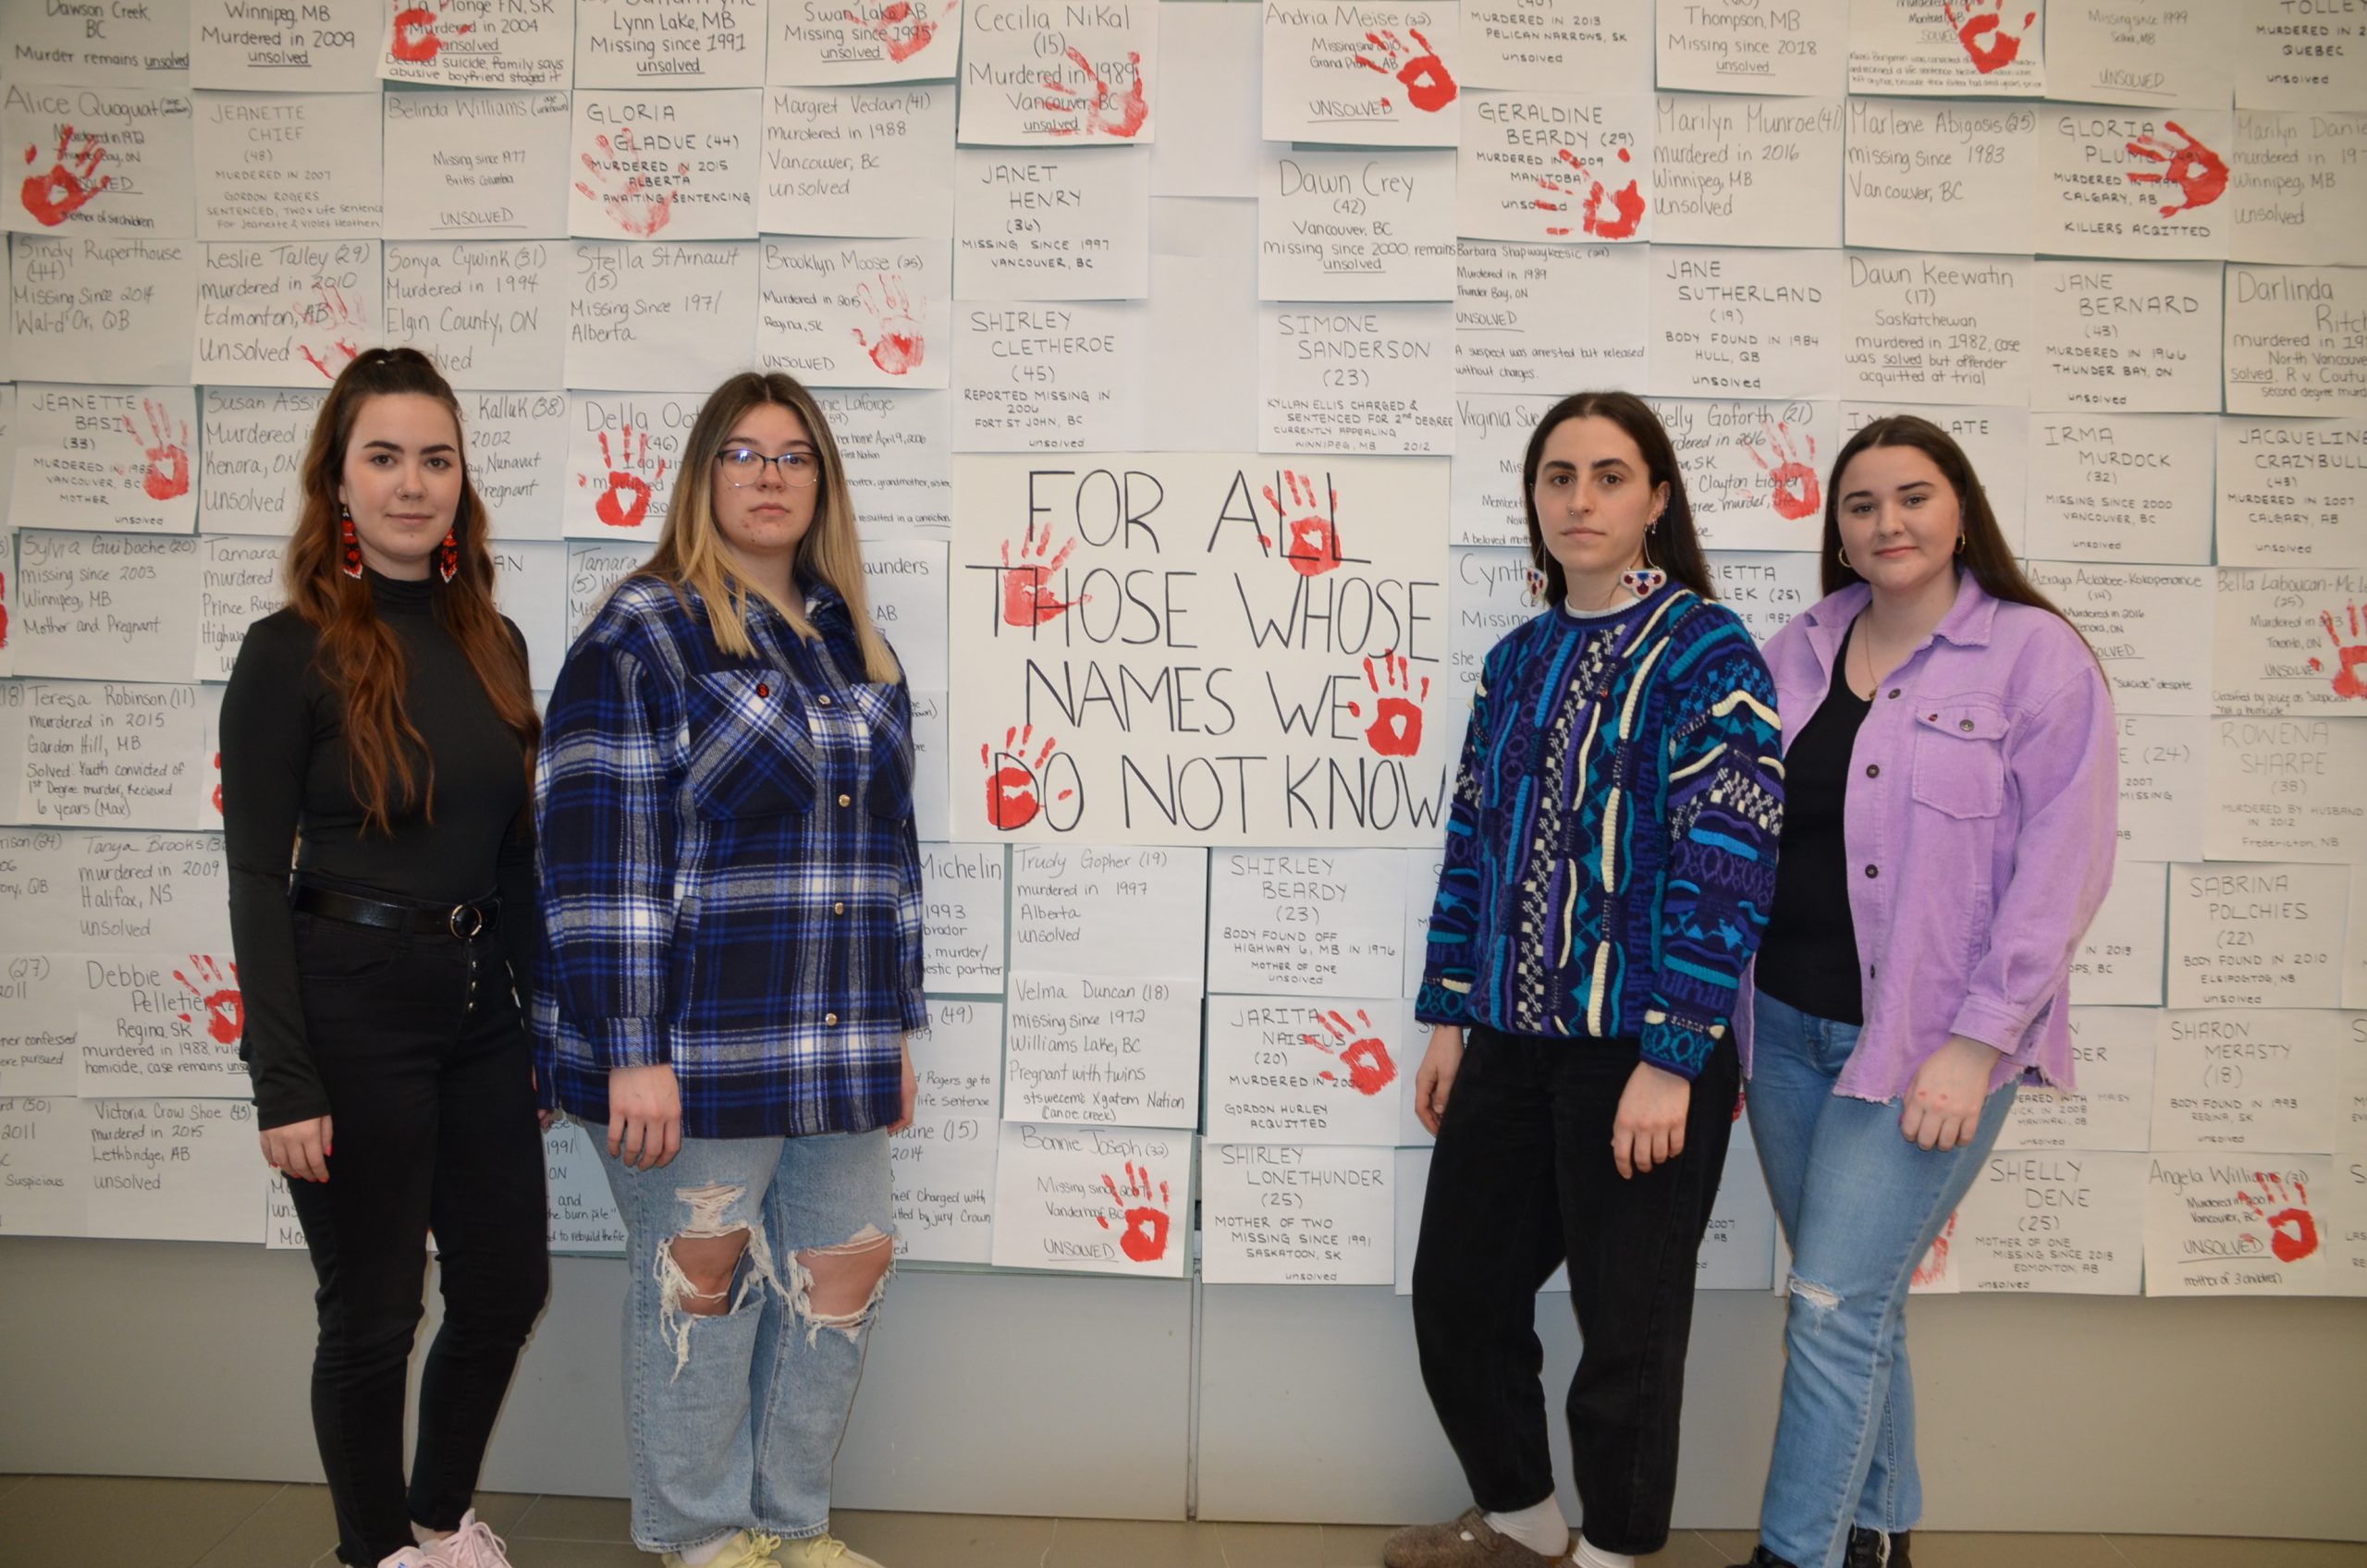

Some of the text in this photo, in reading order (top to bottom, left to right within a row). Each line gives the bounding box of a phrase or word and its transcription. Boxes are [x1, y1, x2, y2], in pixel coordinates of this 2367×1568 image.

[302, 6, 330, 21] MB
[614, 10, 654, 36] Lynn
[703, 16, 735, 29] MB
[1685, 6, 1800, 31] Thompson, MB
[202, 26, 354, 48] Murdered in 2009
[1034, 31, 1066, 58] (15)
[1486, 28, 1627, 42] PELICAN NARROWS, SK
[591, 33, 745, 59] Missing since 1991
[1669, 33, 1817, 57] Missing since 2018
[2283, 44, 2344, 56] QUEBEC
[15, 44, 190, 67] Murder remains unsolved
[248, 51, 308, 65] unsolved
[637, 57, 699, 76] unsolved
[1716, 60, 1769, 73] unsolved
[210, 104, 304, 123] JEANETTE
[587, 104, 675, 124] GLORIA
[1309, 100, 1392, 116] UNSOLVED
[1478, 102, 1602, 124] GERALDINE
[249, 127, 303, 141] CHIEF
[2059, 116, 2153, 140] GLORIA
[614, 133, 739, 152] GLADUE (44)
[1507, 129, 1634, 148] BEARDY (29)
[768, 153, 879, 171] Vancouver, BC
[630, 176, 690, 186] ALBERTA
[982, 165, 1058, 184] JANET
[1278, 159, 1413, 202] Dawn Crey
[1511, 172, 1580, 184] MANITOBA
[1730, 170, 1752, 187] MB
[604, 191, 750, 204] AWAITING SENTENCING
[1010, 190, 1080, 209] HENRY
[1939, 183, 1963, 202] BC
[2063, 191, 2157, 204] CALGARY, AB
[1333, 198, 1366, 215] (42)
[441, 207, 513, 226] UNSOLVED
[2065, 222, 2122, 235] KILLERS
[963, 239, 1109, 251] MISSING SINCE 1997
[389, 248, 440, 278] Sonya
[515, 244, 546, 270] (31)
[991, 257, 1093, 269] VANCOUVER, BC
[1323, 258, 1380, 271] unsolved
[1667, 261, 1721, 279] JANE
[1849, 257, 2013, 288] Dawn Keewatin
[2054, 275, 2113, 292] JANE
[2238, 271, 2334, 303] Darlinda
[1679, 286, 1821, 302] SUTHERLAND
[2080, 296, 2198, 316] BERNARD
[971, 312, 1071, 332] SHIRLEY
[1279, 315, 1378, 336] SIMONE
[572, 324, 636, 342] Alberta
[1666, 331, 1819, 346] BODY FOUND IN 1984
[992, 336, 1114, 357] CLETHEROE
[1299, 340, 1429, 359] SANDERSON
[1455, 345, 1462, 355] A
[1509, 349, 1527, 357] was
[1580, 348, 1598, 358] but
[1603, 347, 1644, 358] released
[1012, 365, 1055, 383] (45)
[1323, 369, 1368, 386] (23)
[2053, 364, 2115, 376] THUNDER
[2156, 368, 2172, 377] ON
[975, 415, 1082, 427] FORT ST JOHN, BC
[2044, 426, 2114, 446] IRMA
[2079, 451, 2171, 467] MURDOCK
[1028, 470, 1371, 564] FOR ALL
[965, 565, 1440, 662] THOSE WHOSE
[1026, 659, 1360, 741] NAMES WE
[2222, 721, 2329, 748] ROWENA
[2241, 753, 2326, 775] SHARPE
[995, 752, 1446, 833] DO NOT KNOW
[1014, 846, 1066, 878] Trudy
[1139, 851, 1167, 868] (19)
[1231, 855, 1333, 876] SHIRLEY
[150, 884, 172, 905] NS
[1263, 881, 1346, 901] BEARDY
[2190, 875, 2287, 898] SABRINA
[1022, 903, 1081, 920] Alberta
[2210, 902, 2308, 920] POLCHIES
[2217, 930, 2253, 949] (22)
[1234, 943, 1290, 953] HIGHWAY
[1319, 945, 1340, 955] MB
[1368, 945, 1395, 956] 1976
[87, 961, 161, 989] Debbie
[1016, 979, 1169, 1002] Velma Duncan (18)
[2171, 1021, 2248, 1040] SHARON
[1012, 1035, 1077, 1053] Williams
[1122, 1036, 1140, 1053] BC
[2205, 1044, 2289, 1060] MERASTY
[94, 1104, 147, 1120] Victoria
[190, 1106, 222, 1121] Shoe
[1251, 1119, 1327, 1129] ACQUITTED
[1221, 1144, 1303, 1164] SHIRLEY
[1990, 1159, 2083, 1182] SHELLY
[1262, 1193, 1302, 1208] (25)
[2026, 1188, 2090, 1208] DENE
[1215, 1217, 1332, 1229] MOTHER OF TWO
[2019, 1216, 2059, 1231] (25)
